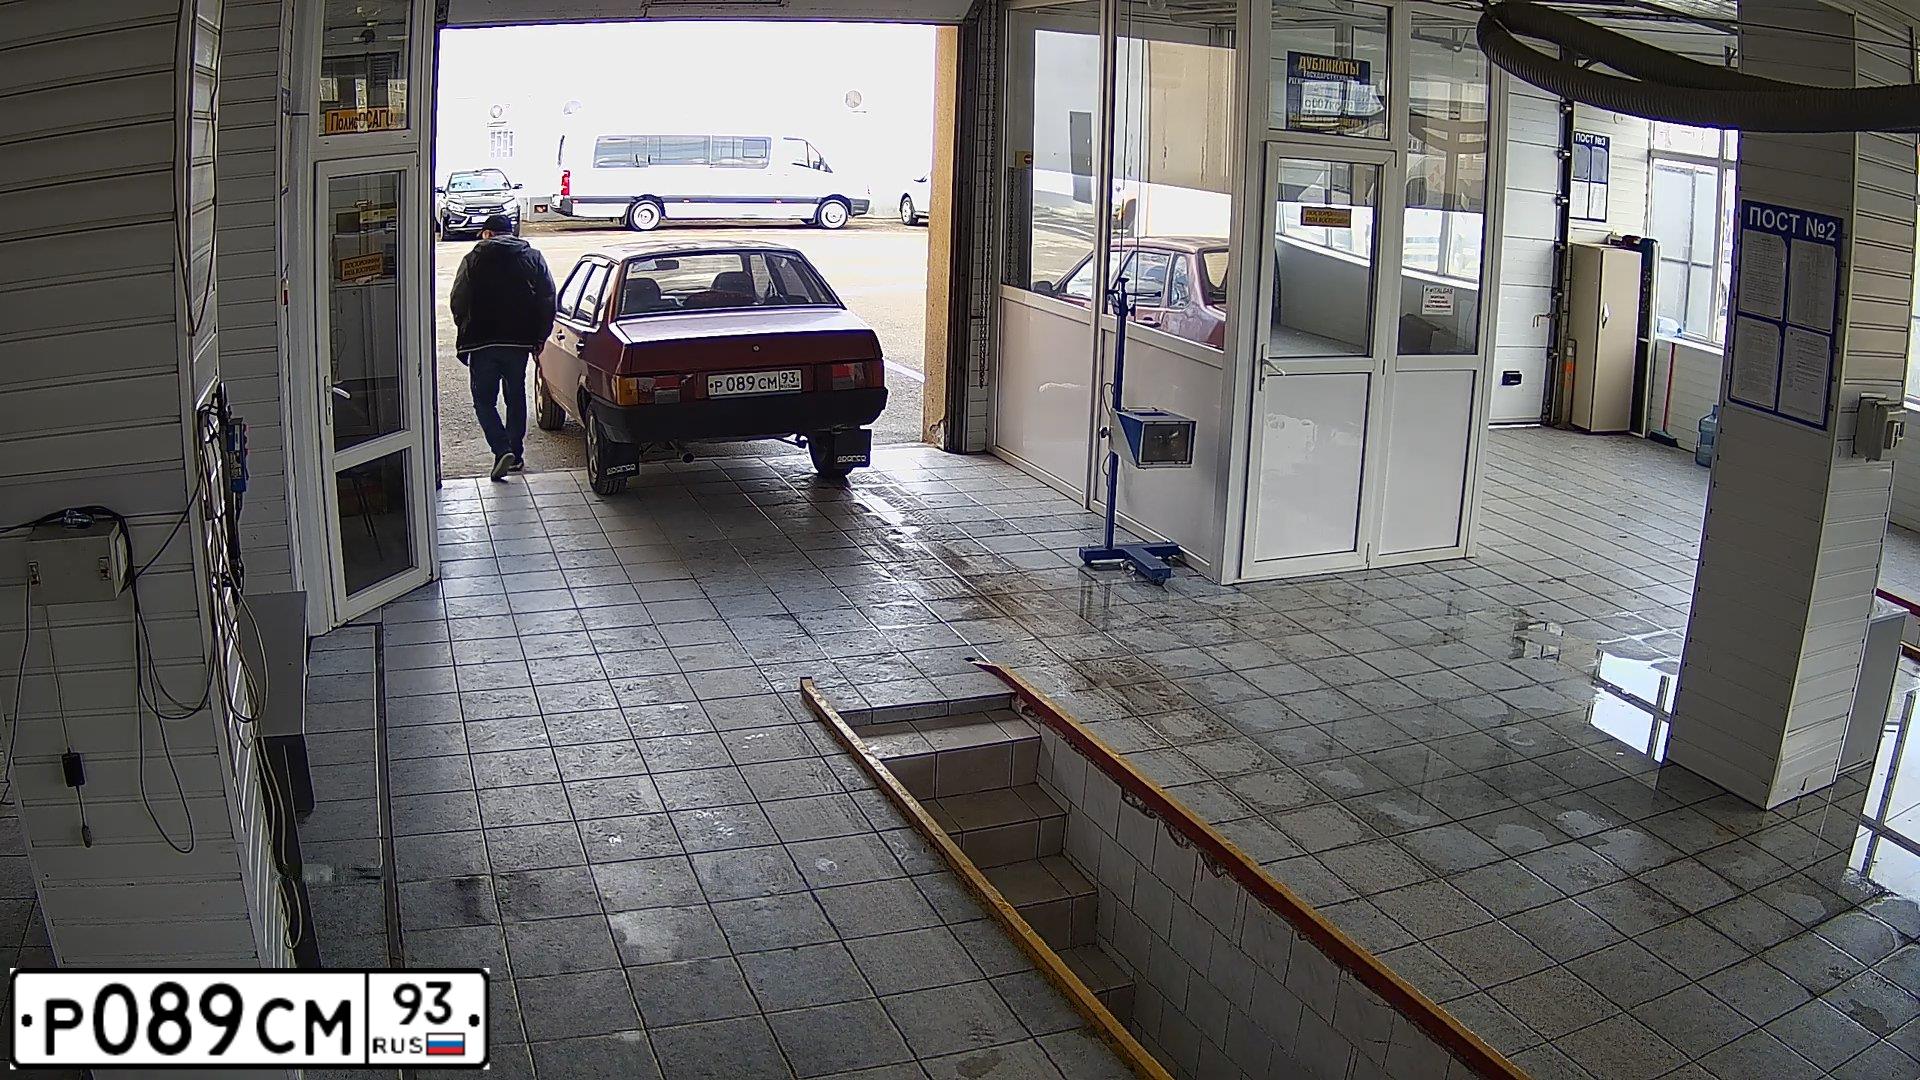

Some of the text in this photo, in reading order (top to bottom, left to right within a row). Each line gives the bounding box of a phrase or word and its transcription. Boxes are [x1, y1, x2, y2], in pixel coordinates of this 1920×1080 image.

[1298, 56, 1359, 75] ДУБЛИКАТЫ
[1575, 132, 1594, 144] ПОСТ
[1749, 206, 1836, 242] ПОСТ №2
[781, 372, 796, 384] 93
